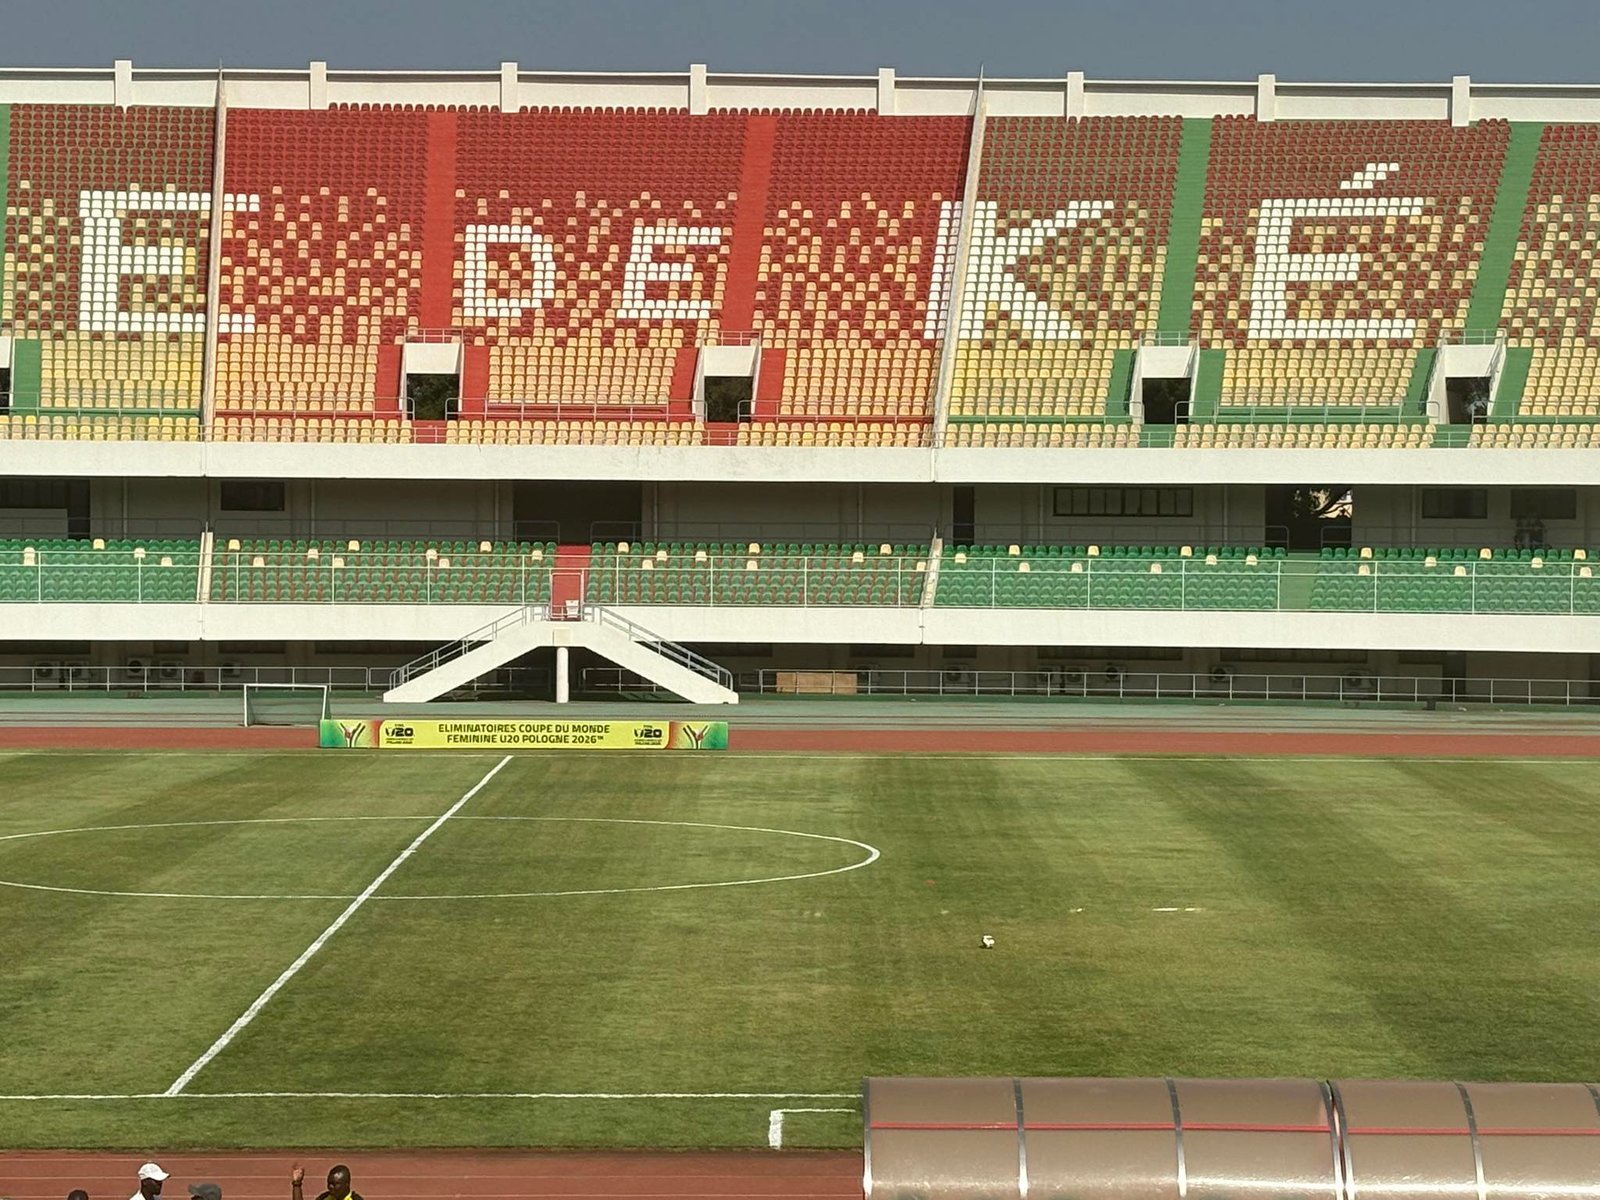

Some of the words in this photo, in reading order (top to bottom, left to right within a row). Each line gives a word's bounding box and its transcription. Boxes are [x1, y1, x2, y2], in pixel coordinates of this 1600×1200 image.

[463, 224, 721, 319] DE
[438, 723, 516, 733] ELIMINATOIRES
[518, 723, 553, 733] COUPE
[555, 724, 570, 733] DU
[572, 724, 610, 733] MONDE
[447, 735, 498, 743] FEMININE
[500, 735, 520, 743] U20
[522, 735, 570, 743] POLOGNE
